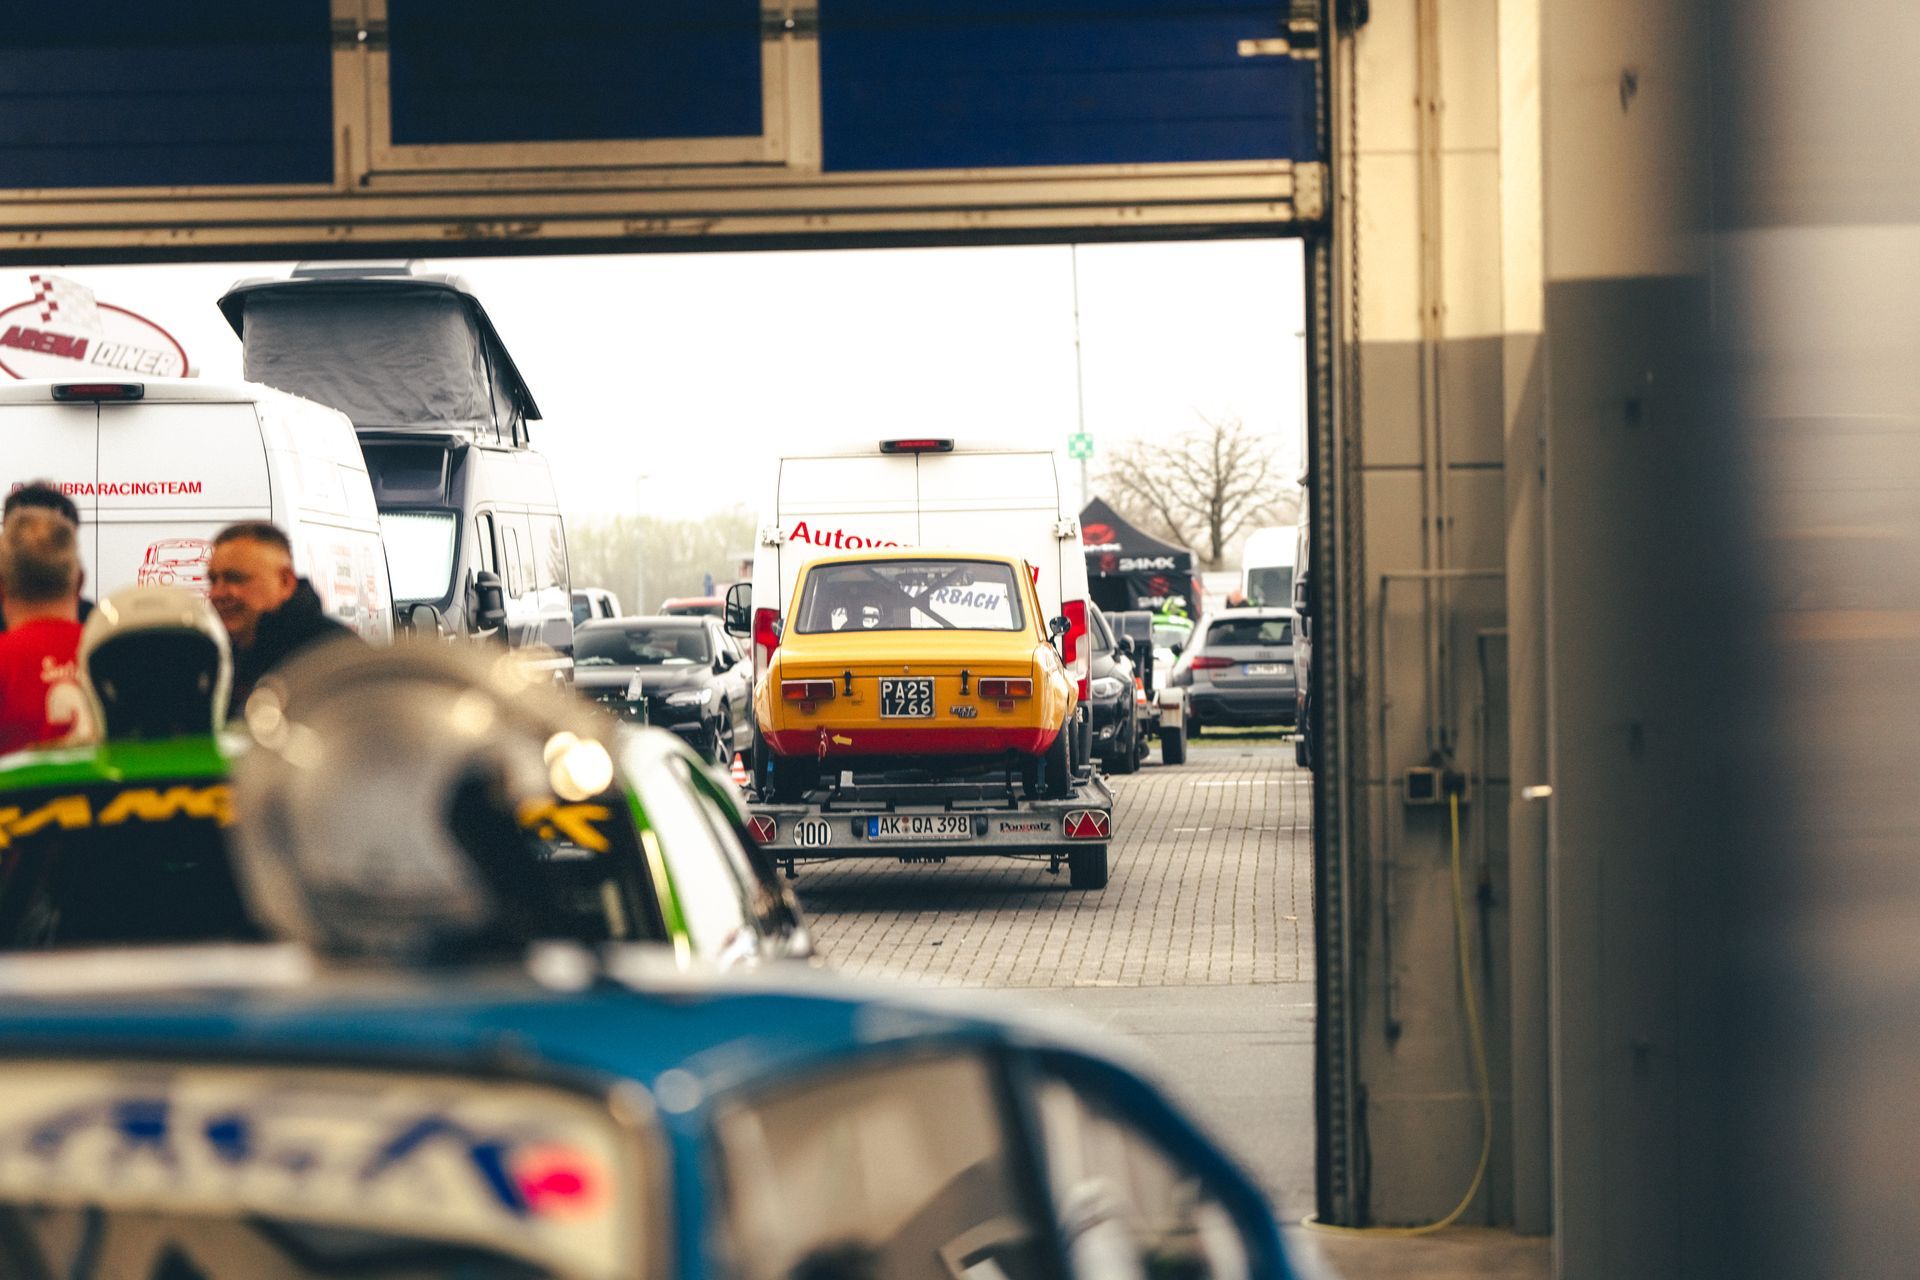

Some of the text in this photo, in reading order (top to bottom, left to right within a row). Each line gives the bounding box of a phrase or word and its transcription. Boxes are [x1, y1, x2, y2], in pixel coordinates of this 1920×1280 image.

[0, 326, 177, 377] ARENA DINER
[885, 699, 931, 715] 1766
[798, 822, 828, 846] 100
[880, 817, 900, 834] AK
[912, 816, 933, 834] QA
[937, 816, 967, 833] 398
